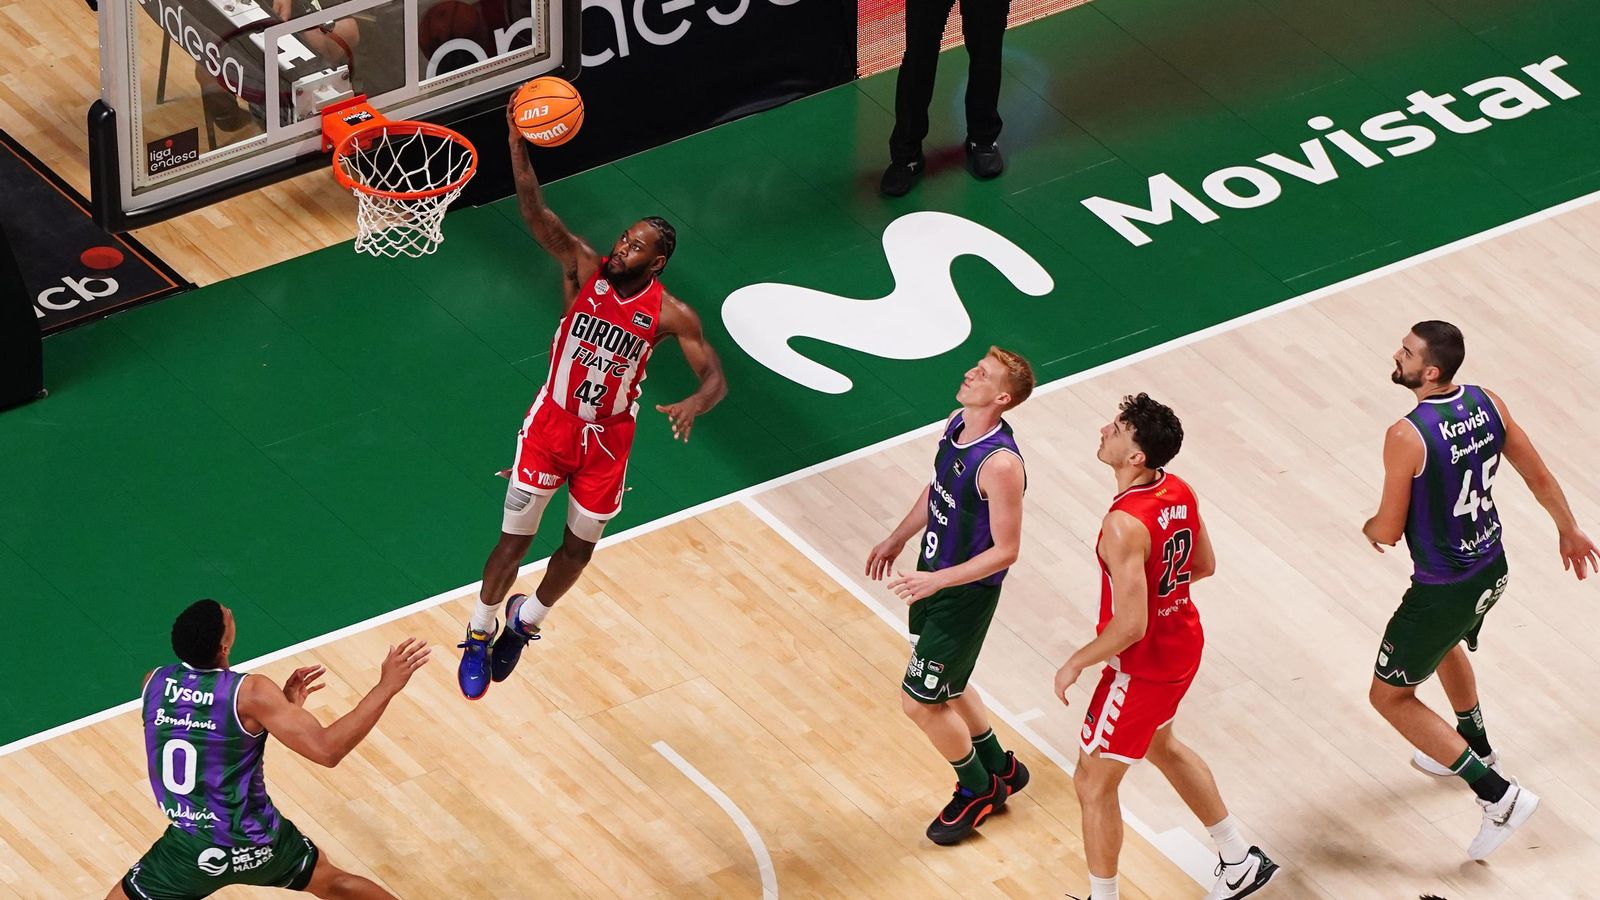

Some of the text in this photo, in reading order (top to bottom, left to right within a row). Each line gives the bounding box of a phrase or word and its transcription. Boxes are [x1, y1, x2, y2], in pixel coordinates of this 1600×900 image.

[523, 122, 568, 141] Wilson
[150, 148, 171, 162] liga
[150, 150, 197, 172] endesa
[1080, 55, 1582, 247] Movistar
[32, 275, 119, 319] cb
[571, 312, 647, 362] GIRONA
[571, 346, 630, 377] FIATC
[573, 379, 608, 407] 42
[1438, 406, 1490, 441] Kravish
[1453, 453, 1498, 522] 45
[925, 531, 939, 559] 9
[1157, 527, 1192, 598] 22
[164, 677, 214, 706] Tyson
[162, 738, 197, 796] 0
[232, 853, 254, 865] DEL
